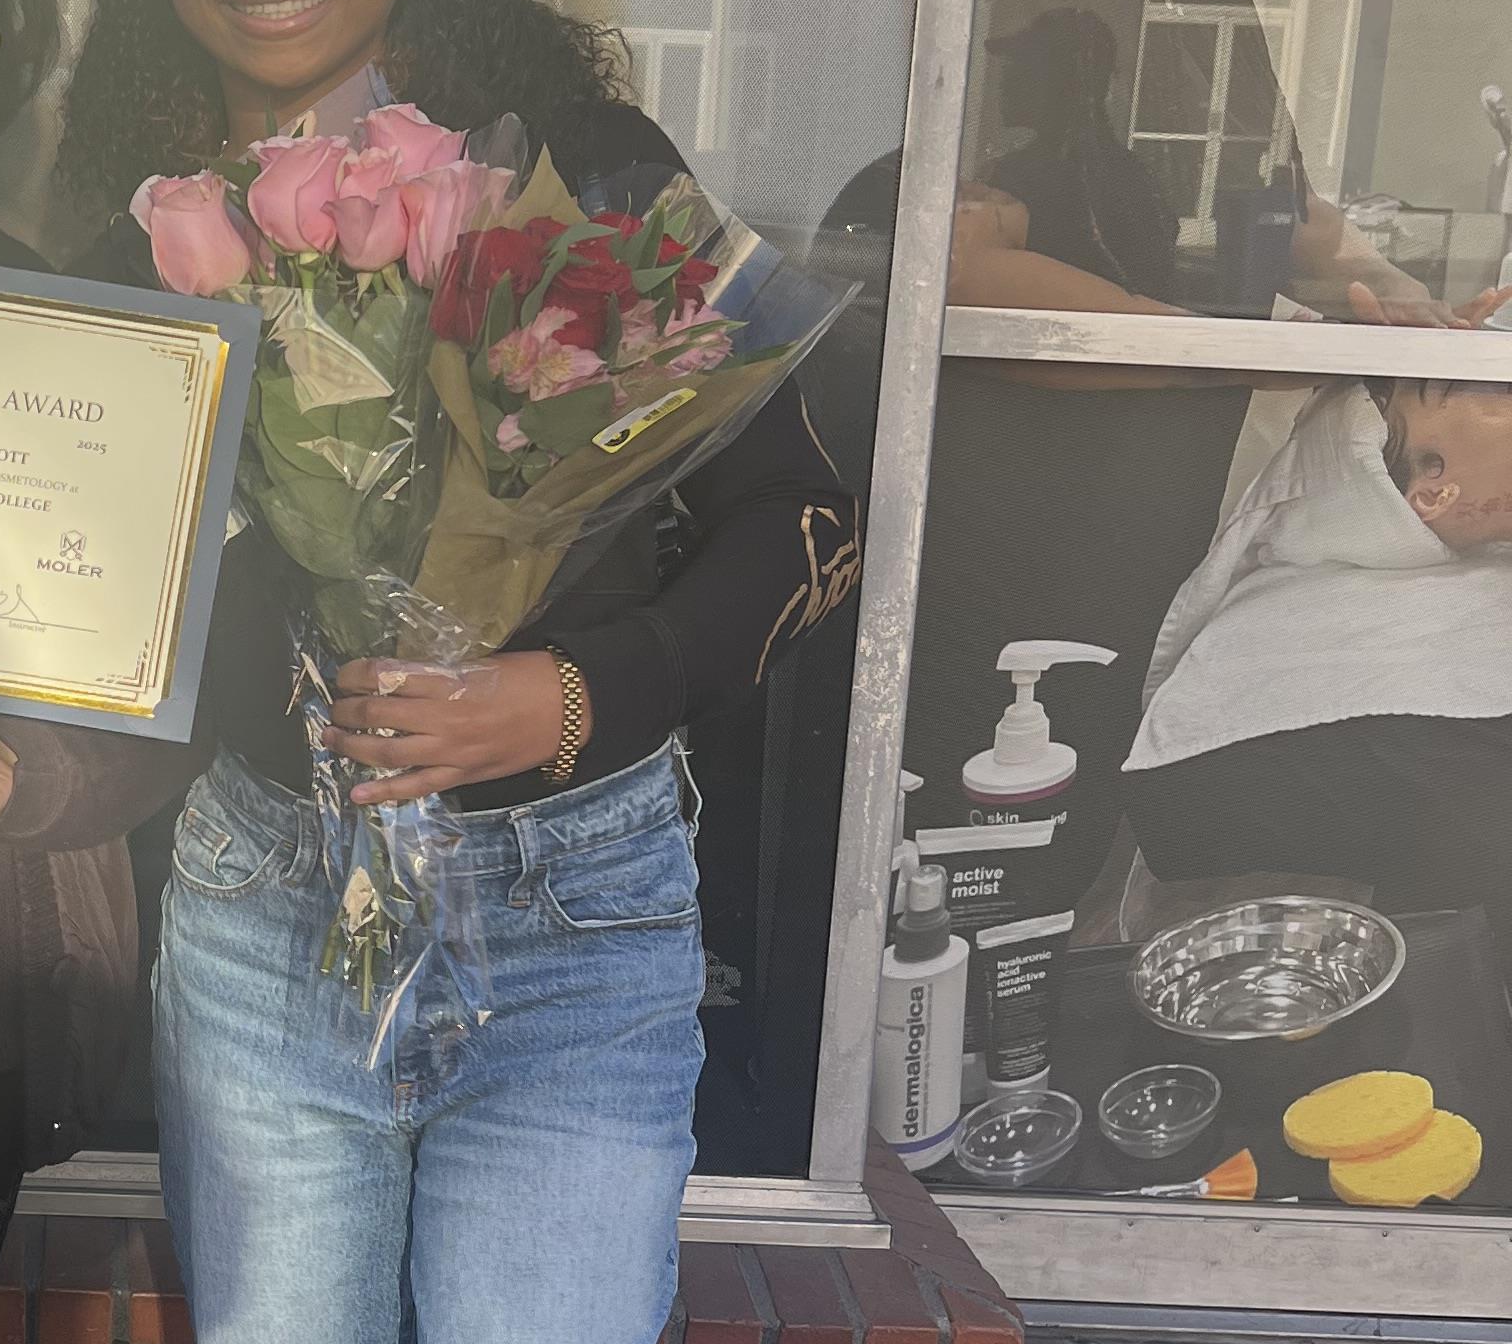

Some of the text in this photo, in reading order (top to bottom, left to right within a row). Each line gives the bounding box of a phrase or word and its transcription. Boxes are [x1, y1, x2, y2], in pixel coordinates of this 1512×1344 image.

[2, 390, 104, 423] AWARD
[76, 439, 107, 456] 2025
[36, 558, 104, 579] MOLER
[987, 811, 1020, 825] skin
[953, 866, 1005, 882] active
[951, 881, 1000, 898] moist
[996, 950, 1052, 970] hyaluronic
[996, 965, 1020, 979] acid
[996, 970, 1047, 989] ionactive
[996, 982, 1032, 998] serum
[902, 985, 925, 1138] dermalogica
